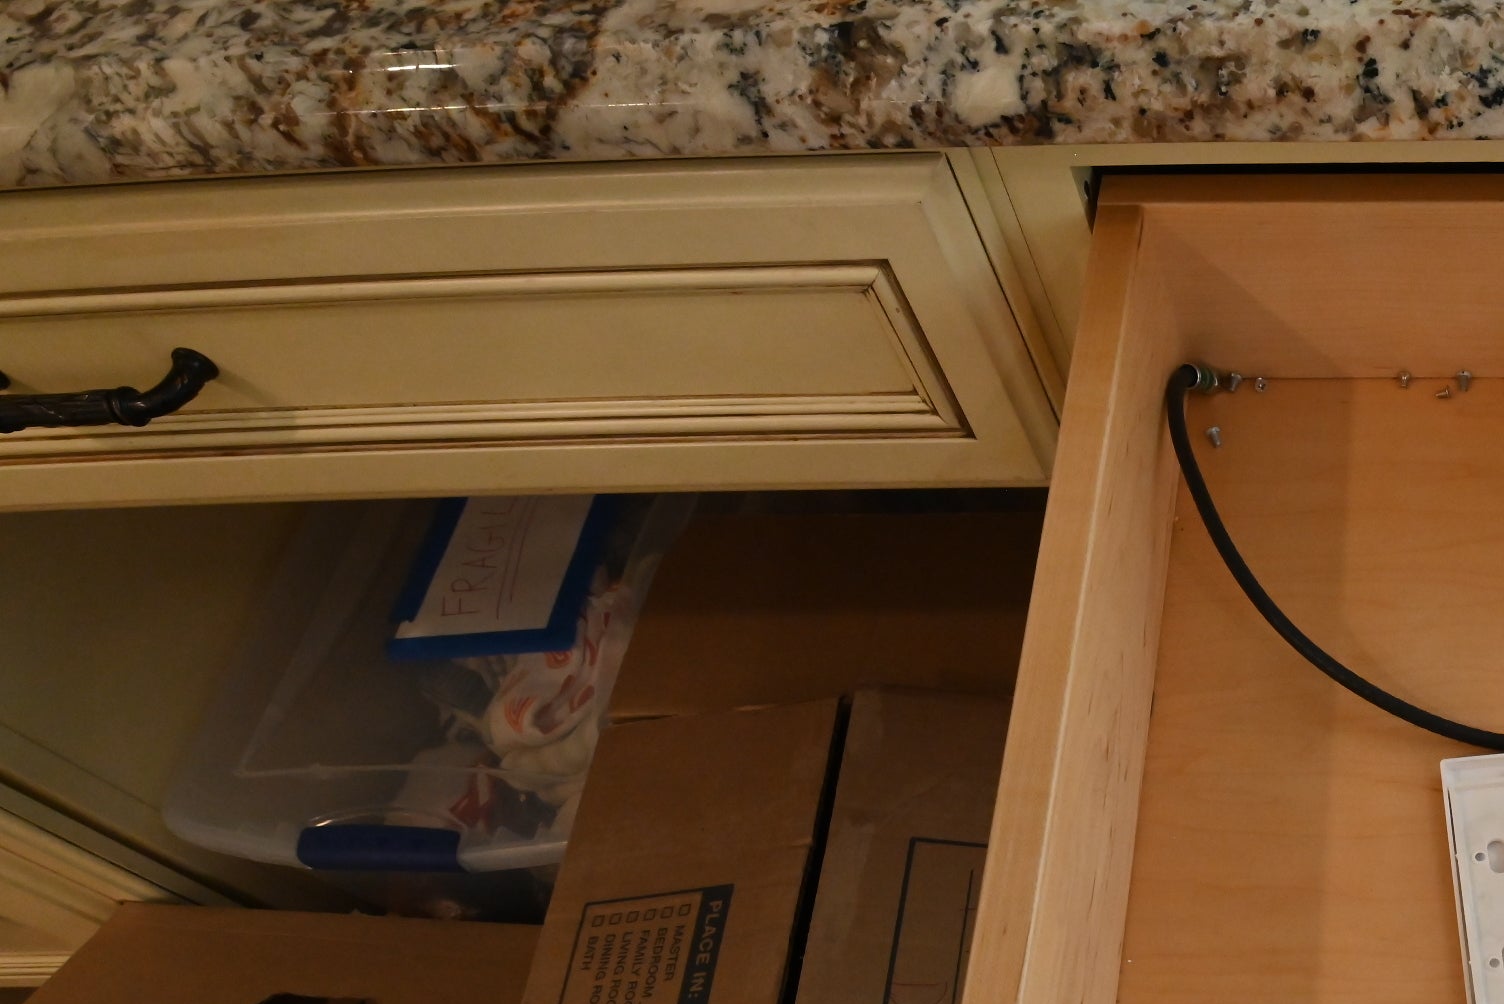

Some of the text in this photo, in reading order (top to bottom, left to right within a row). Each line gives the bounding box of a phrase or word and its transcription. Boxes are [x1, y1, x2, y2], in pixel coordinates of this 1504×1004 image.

[581, 935, 599, 971] BATH
[595, 933, 616, 981] DINING
[612, 931, 633, 978] LIVING
[629, 929, 651, 979] FAMILY
[642, 927, 667, 999] BEDROOM
[664, 925, 687, 981] MASTER
[687, 899, 724, 999] PLACE IN:
